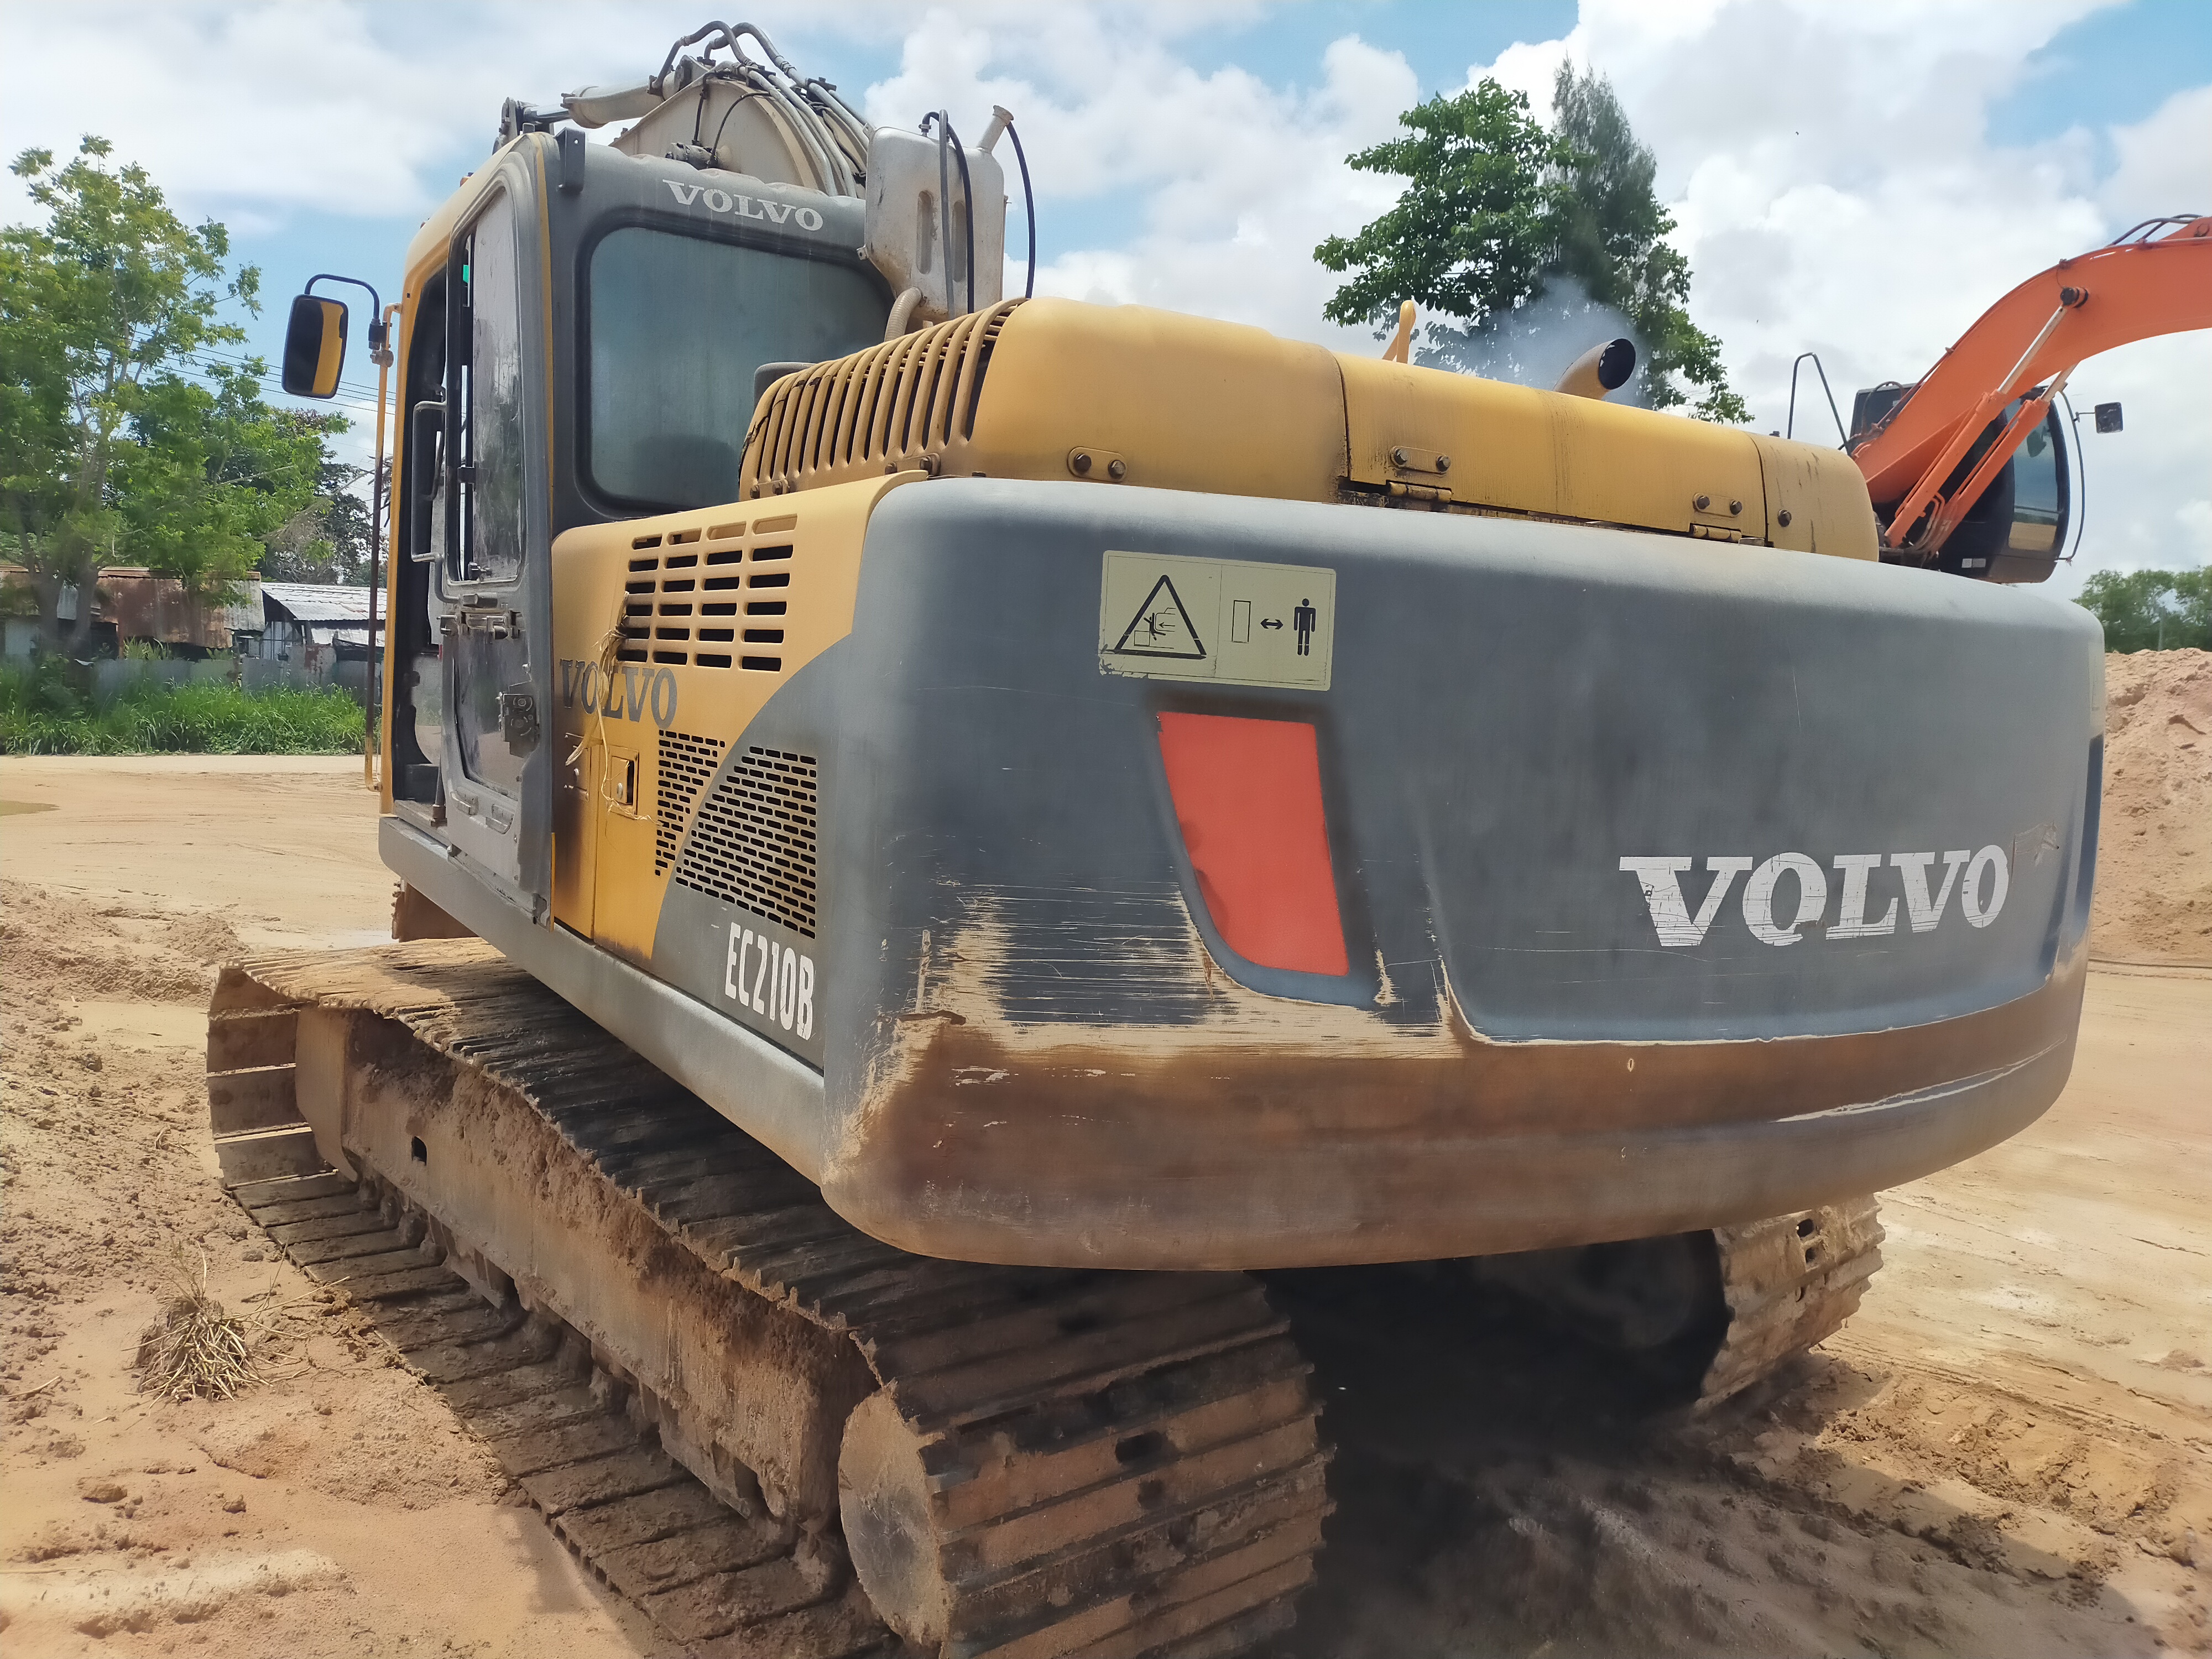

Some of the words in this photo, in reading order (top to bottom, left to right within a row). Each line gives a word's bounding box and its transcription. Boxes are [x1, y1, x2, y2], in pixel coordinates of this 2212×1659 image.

[662, 179, 823, 231] VOLVO
[559, 658, 677, 729] VOLVO
[1619, 844, 2010, 947] VOLVO
[726, 922, 814, 1041] EC210B
